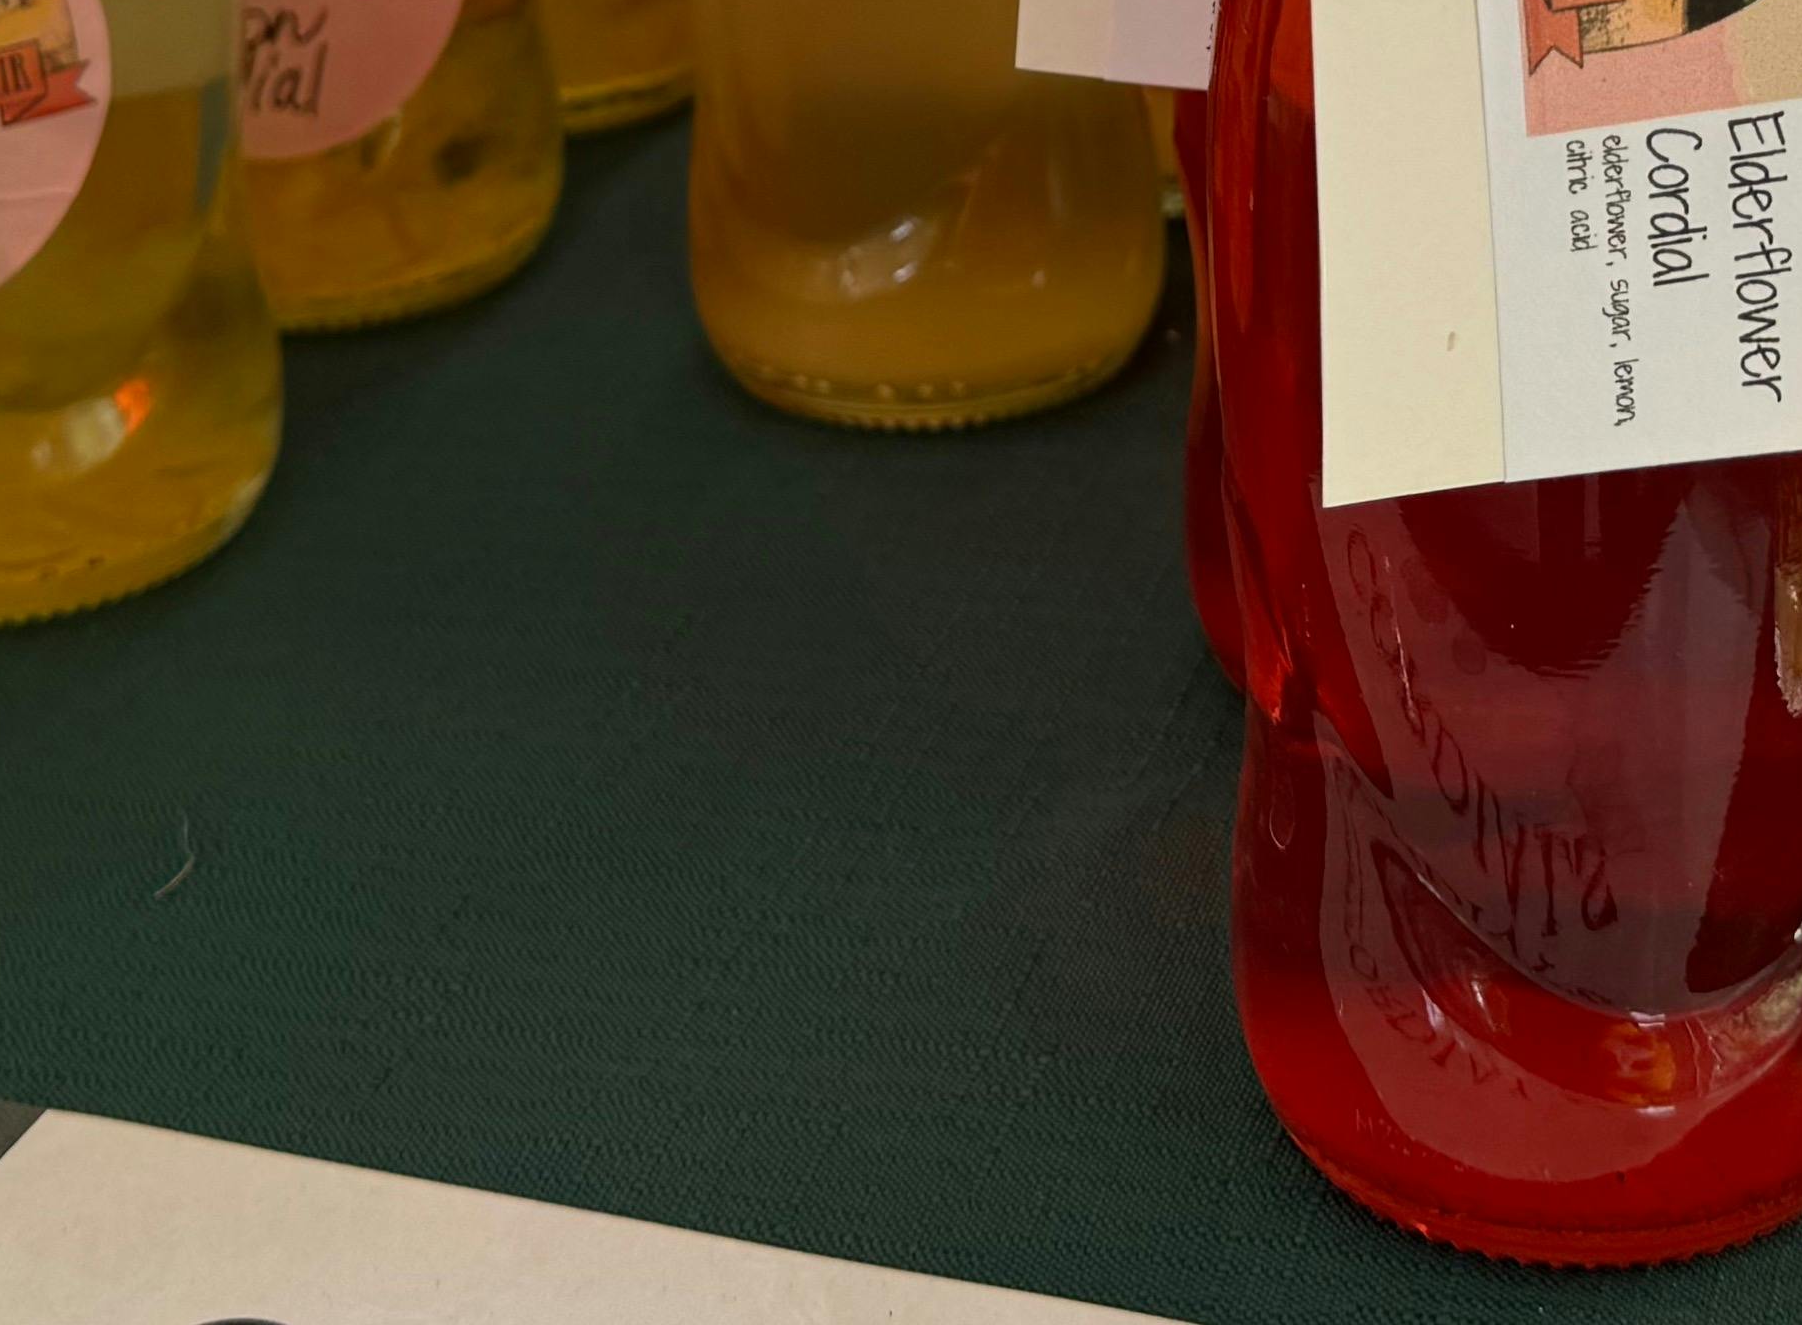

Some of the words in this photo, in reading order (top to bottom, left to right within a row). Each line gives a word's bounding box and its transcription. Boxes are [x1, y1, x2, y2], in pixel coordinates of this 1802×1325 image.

[1566, 139, 1598, 194] citric
[1646, 128, 1710, 287] Cordial
[1569, 210, 1598, 252] acid
[1728, 110, 1792, 404] Elderflower
